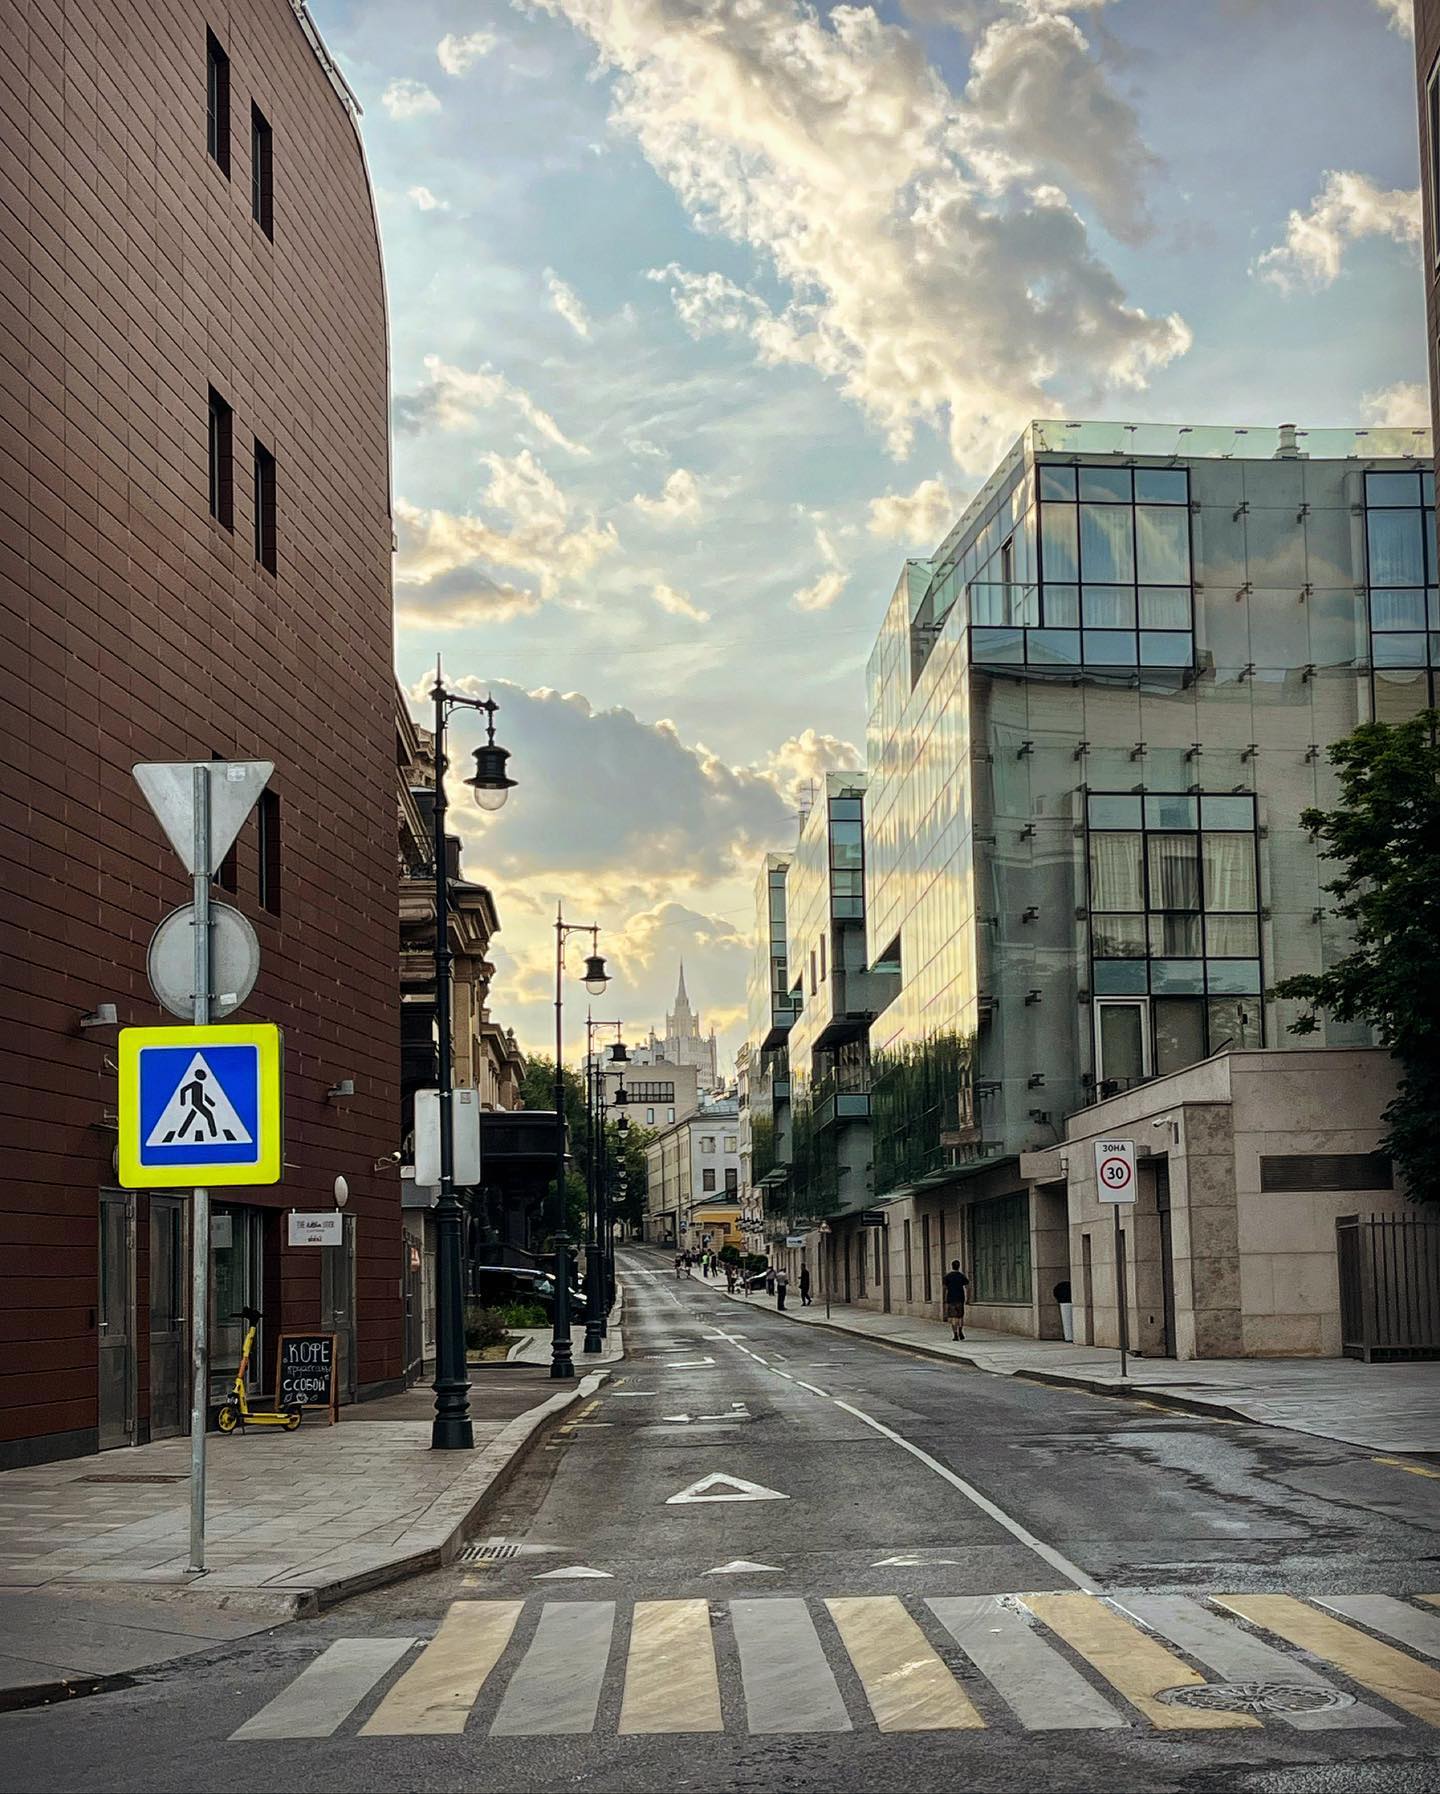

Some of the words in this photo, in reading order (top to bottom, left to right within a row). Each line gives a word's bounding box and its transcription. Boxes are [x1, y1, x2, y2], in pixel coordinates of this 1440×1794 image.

[1102, 1144, 1126, 1153] ЗОНА
[1107, 1166, 1124, 1180] 30
[288, 1341, 330, 1363] КОФЕ
